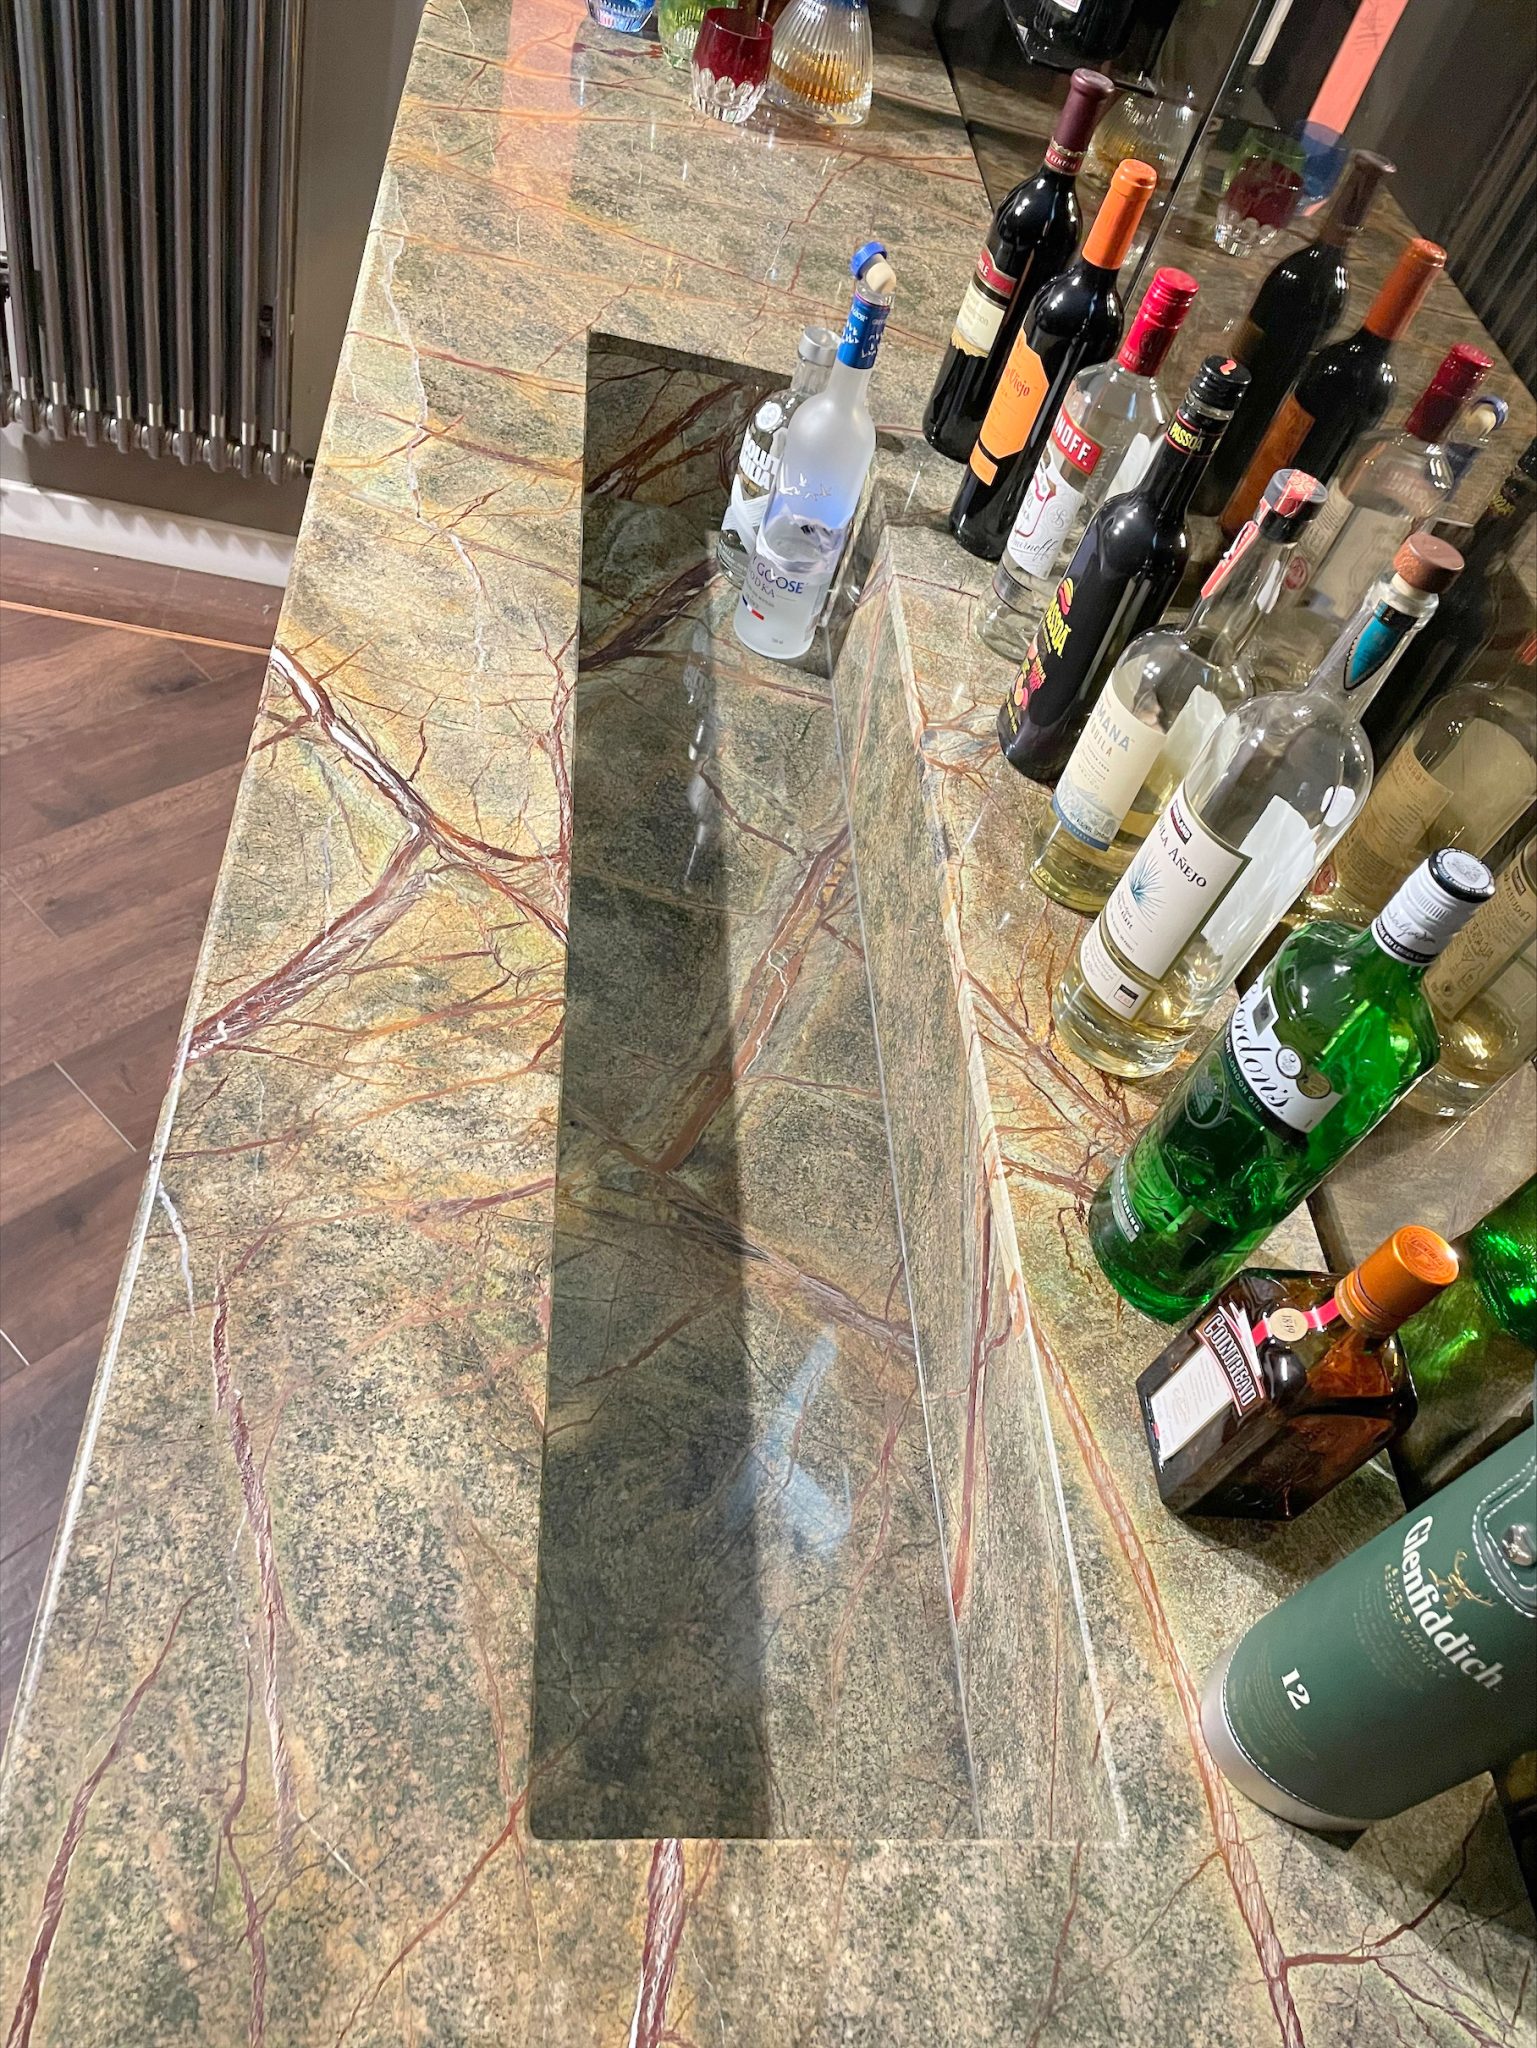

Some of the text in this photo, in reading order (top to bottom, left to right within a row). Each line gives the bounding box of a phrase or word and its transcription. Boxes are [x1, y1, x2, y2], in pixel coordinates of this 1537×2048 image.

[1009, 368, 1031, 398] Viejo
[1053, 414, 1091, 462] NOFF
[756, 562, 804, 594] GOOSE
[1168, 847, 1207, 888] AÑEJO
[1227, 1054, 1249, 1095] LONDON
[1247, 1094, 1264, 1113] GIN
[1203, 1313, 1256, 1406] COINTREAU
[1402, 1515, 1505, 1693] Glenfiddich
[1280, 1668, 1311, 1711] 12
